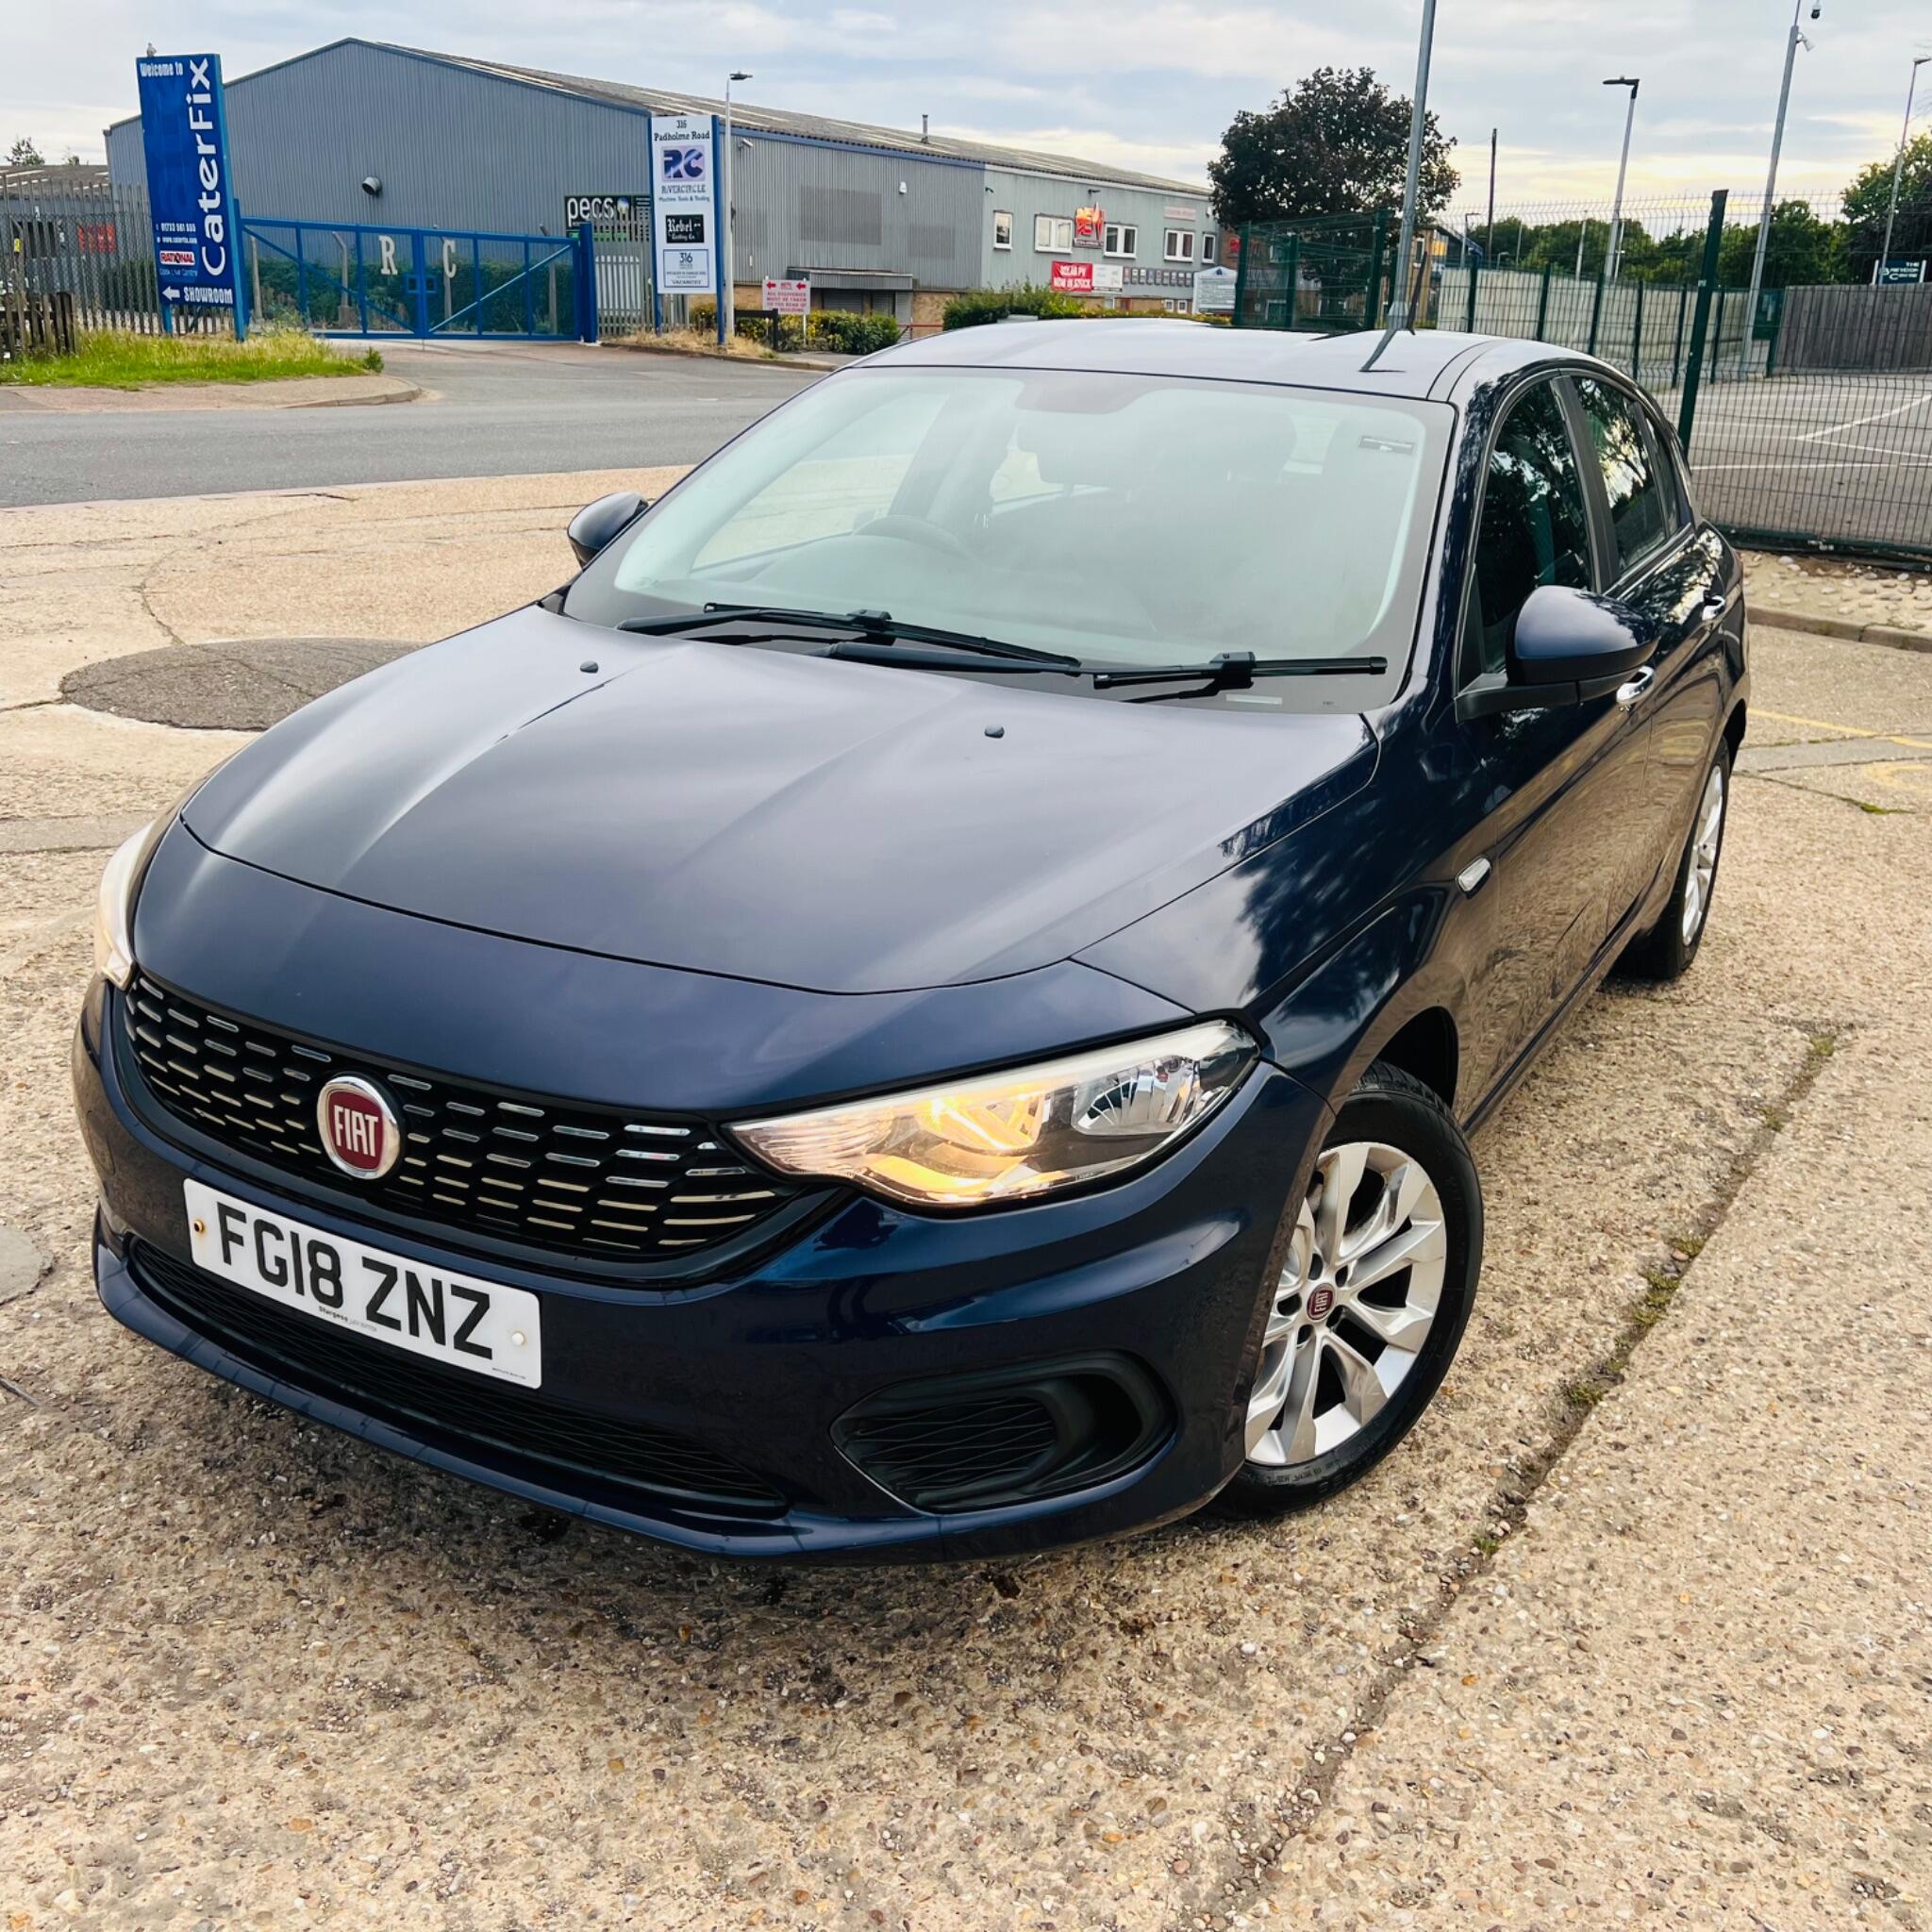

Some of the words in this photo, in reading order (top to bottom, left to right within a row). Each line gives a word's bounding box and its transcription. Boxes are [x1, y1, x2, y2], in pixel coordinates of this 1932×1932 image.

[140, 63, 174, 77] Welcome
[175, 61, 183, 75] to
[654, 132, 691, 141] Padholme
[691, 130, 710, 140] Road
[186, 58, 225, 276] CaterFix
[567, 198, 614, 227] pecs
[161, 252, 194, 264] RATIONAL
[378, 235, 398, 275] R
[443, 238, 457, 278] C
[183, 286, 233, 304] SHOWROOM
[333, 1104, 378, 1158] FIAT
[217, 1201, 343, 1309] FG18
[361, 1256, 492, 1360] ZNZ
